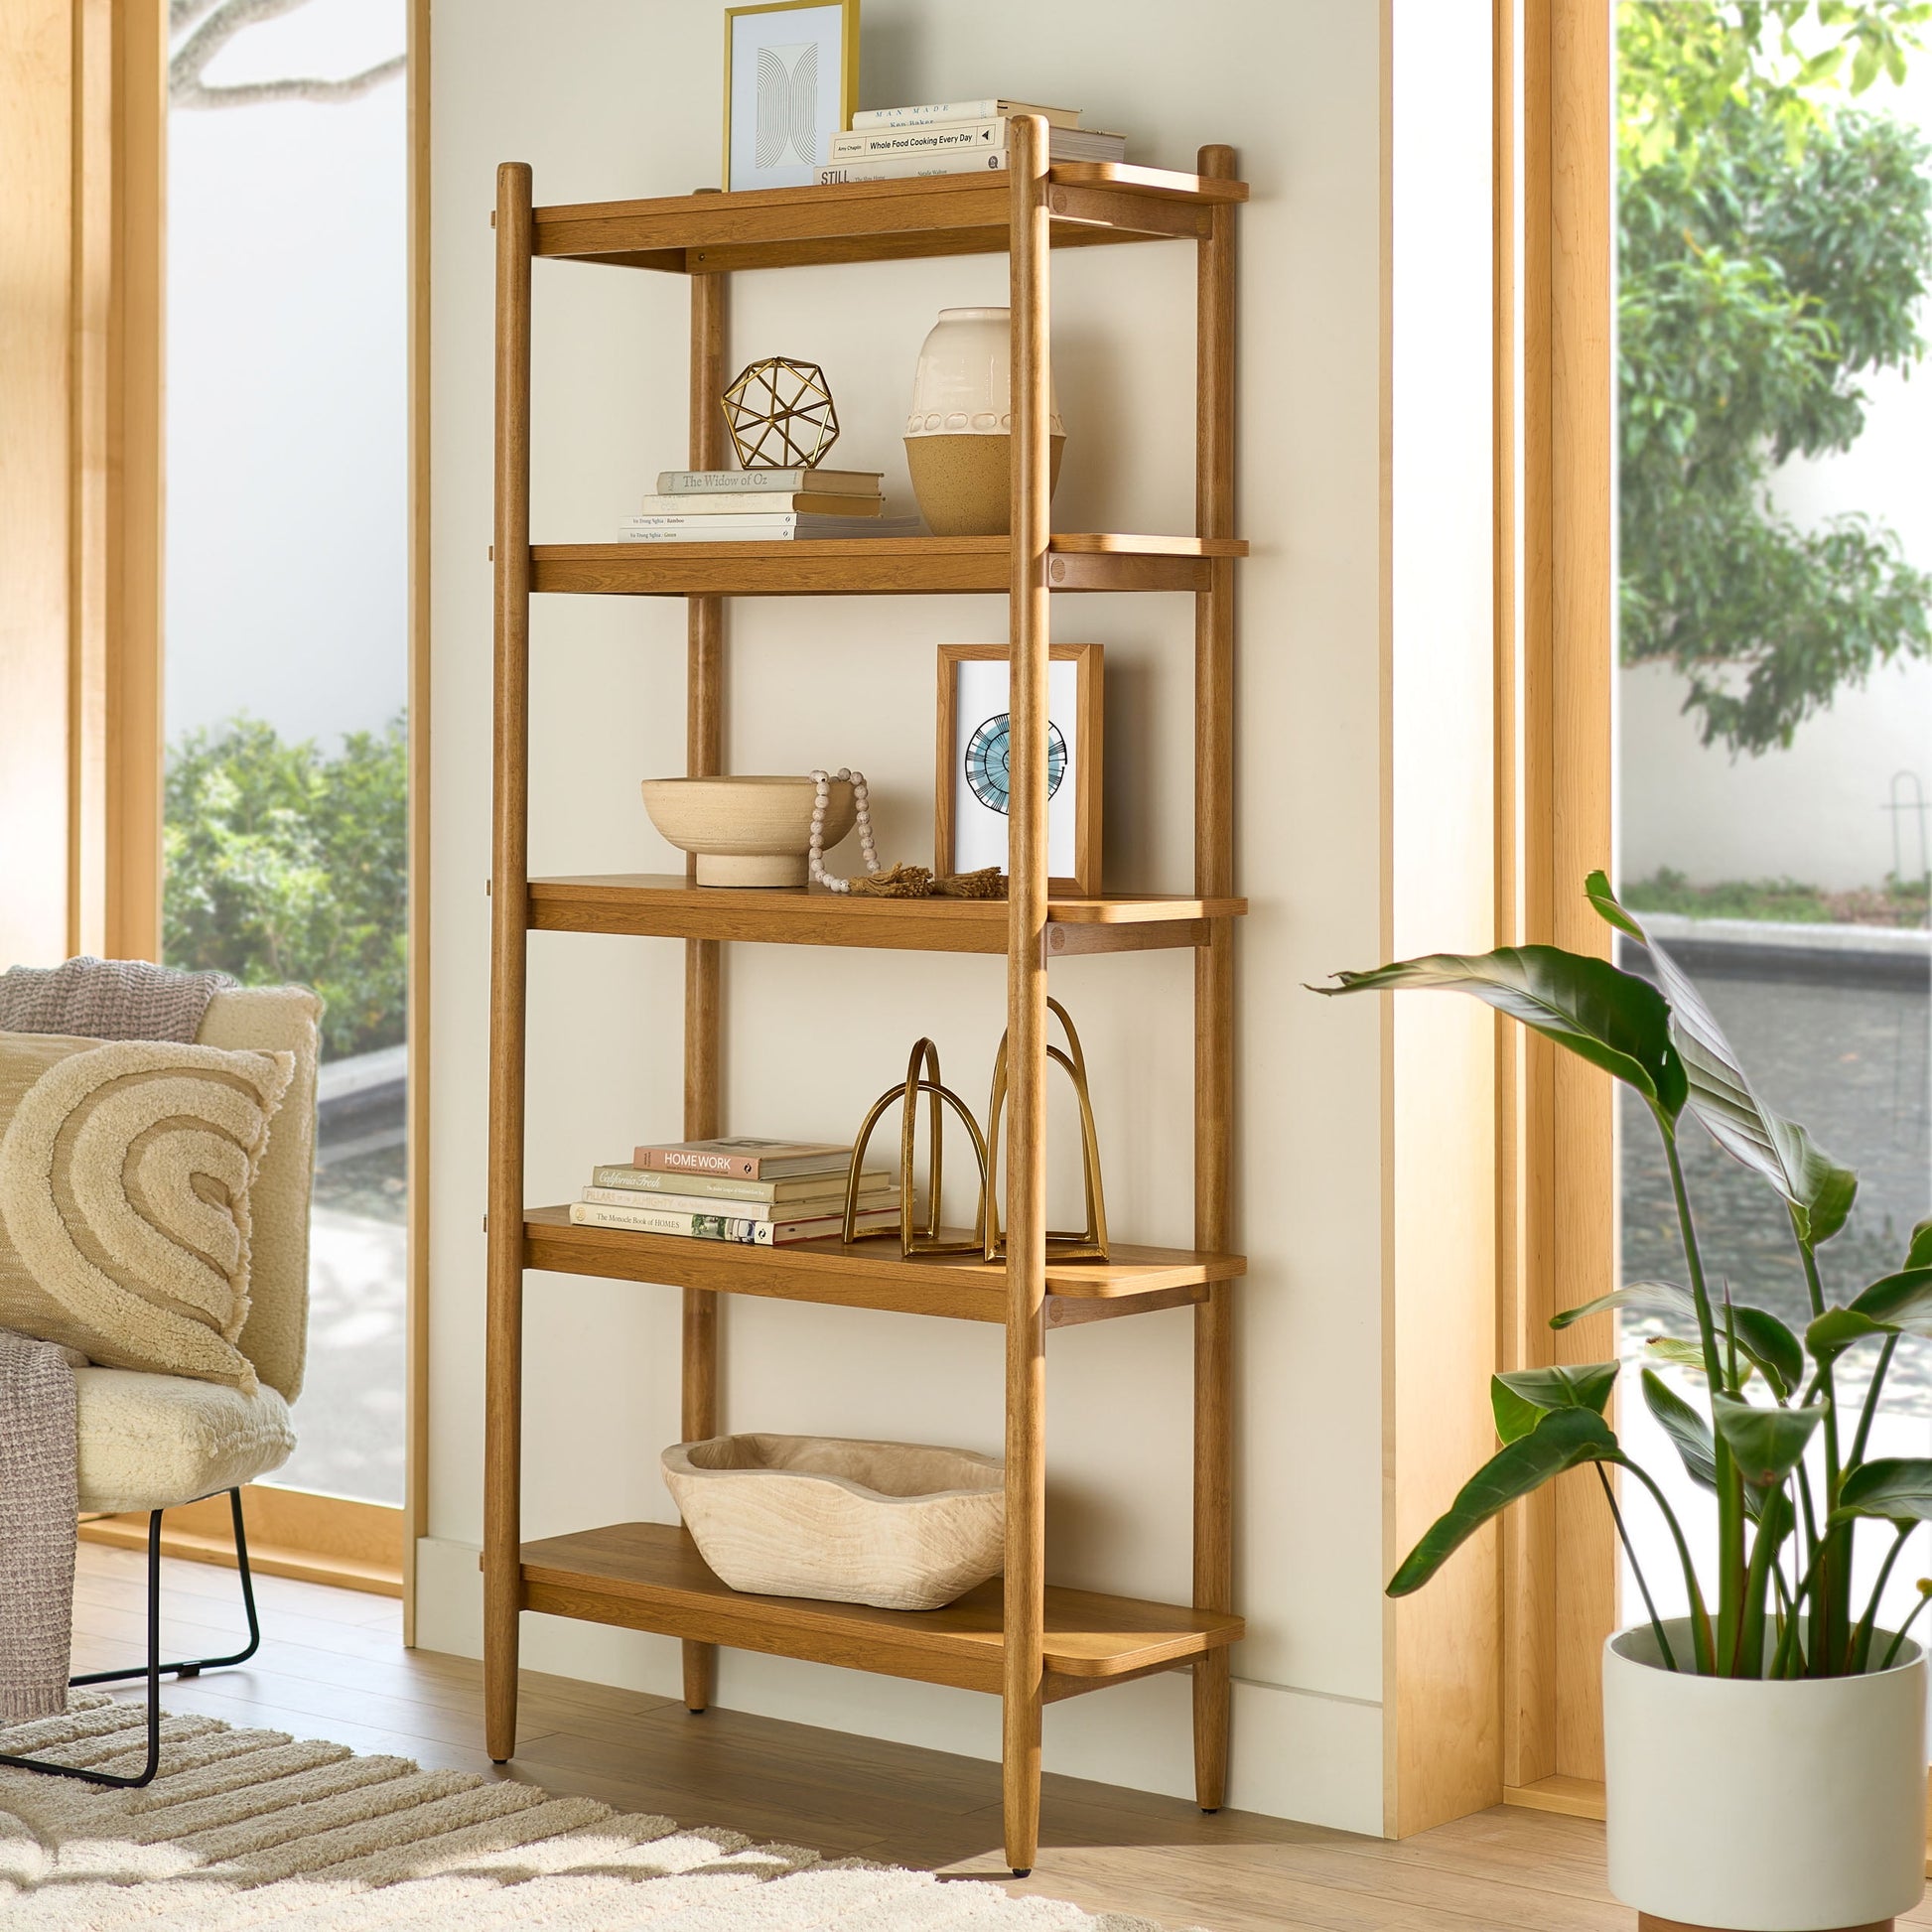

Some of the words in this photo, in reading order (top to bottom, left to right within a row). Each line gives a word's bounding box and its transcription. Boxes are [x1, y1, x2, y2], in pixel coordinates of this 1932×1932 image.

[870, 141, 891, 150] Whole
[892, 139, 909, 148] Food
[909, 137, 938, 146] Cooking
[938, 135, 959, 144] Every
[821, 170, 850, 185] STILL
[683, 475, 702, 487] The
[704, 474, 739, 486] Widow
[741, 474, 753, 485] of
[754, 473, 768, 485] Oz
[599, 1171, 635, 1186] California
[635, 1173, 662, 1188] Fresh
[597, 1212, 607, 1221] The
[609, 1214, 632, 1224] Monocle
[654, 1219, 680, 1229] HOMES
